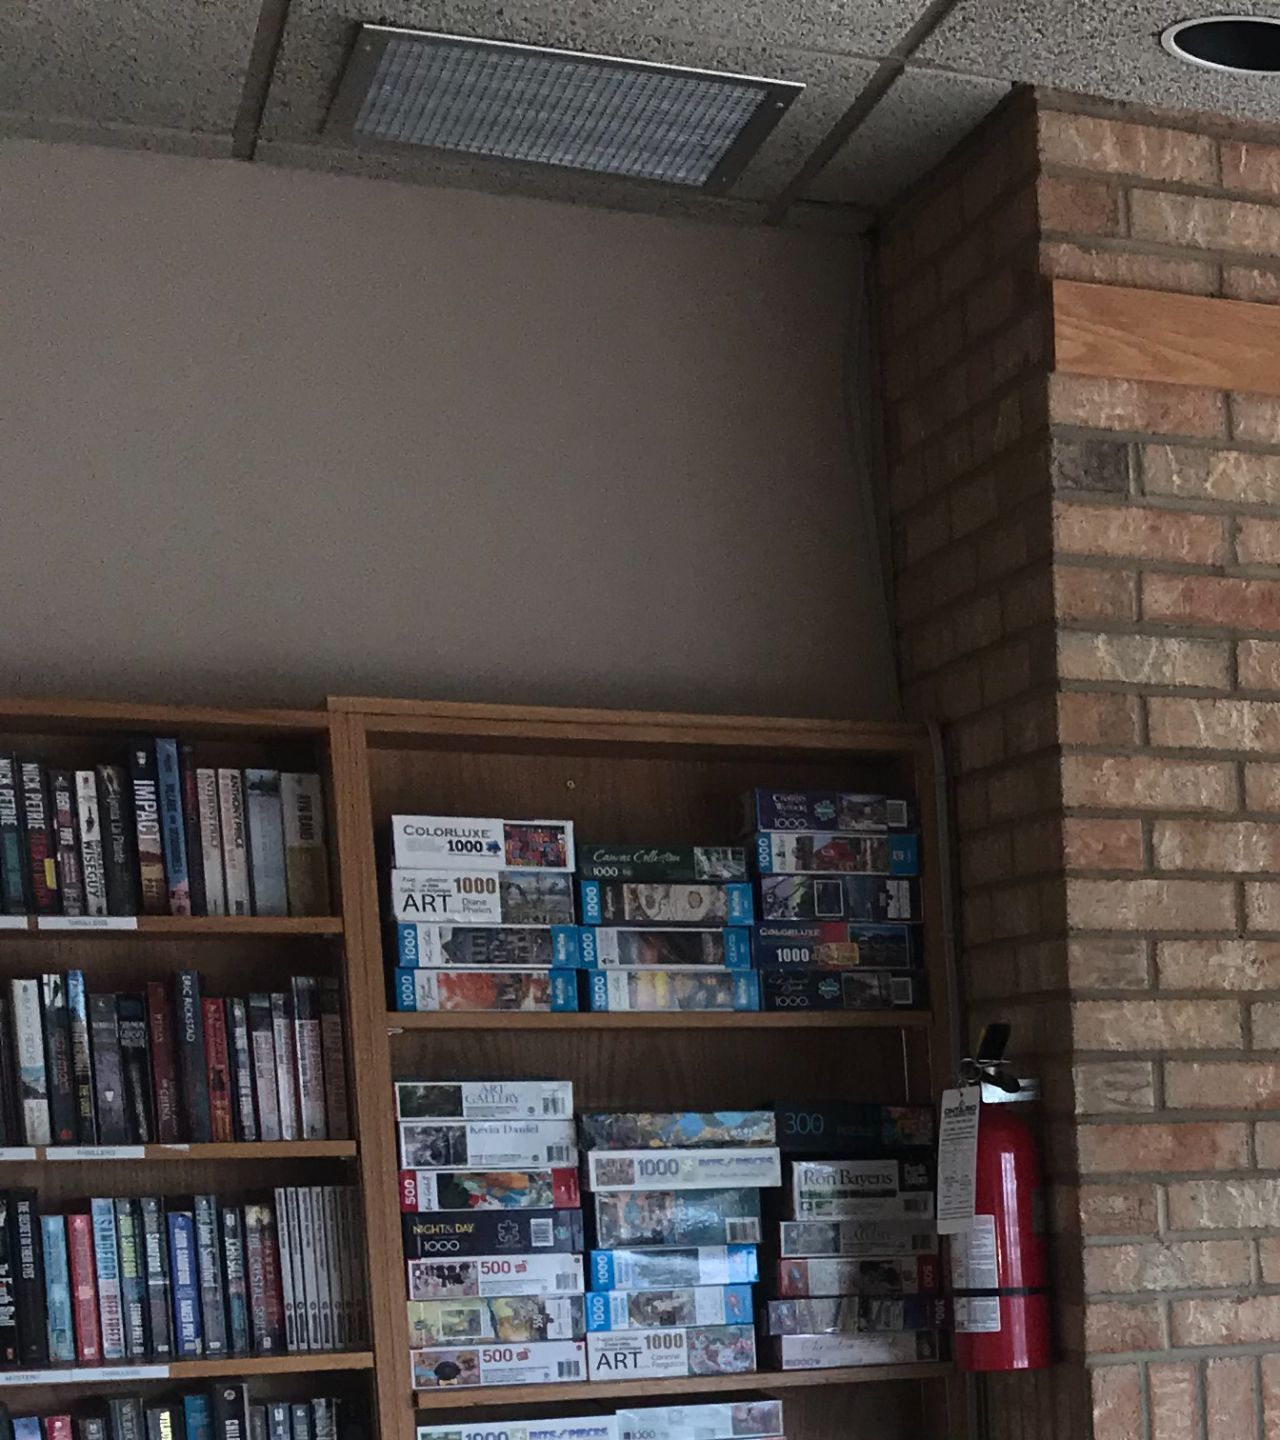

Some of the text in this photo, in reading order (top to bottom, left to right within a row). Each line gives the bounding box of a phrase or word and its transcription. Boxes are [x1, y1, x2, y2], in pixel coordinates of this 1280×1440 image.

[25, 792, 45, 830] PETRIE
[133, 780, 160, 840] IMPACT
[774, 817, 809, 830] 1000
[447, 840, 483, 853] 1000
[758, 838, 769, 868] 1000
[83, 841, 100, 898] WISEGUY
[592, 866, 619, 877] 1000
[454, 877, 497, 894] 1000
[402, 893, 453, 913] ART
[586, 886, 600, 917] 1000
[404, 929, 416, 961] 1000
[582, 932, 596, 963] 1000
[775, 948, 810, 963] 1000
[401, 975, 414, 1006] 1000
[594, 975, 607, 1007] 1000
[775, 995, 809, 1007] 1000
[465, 1093, 520, 1104] GALLERY
[481, 1085, 503, 1095] ART
[783, 1112, 825, 1135] 300
[638, 1159, 680, 1176] 1000
[803, 1168, 837, 1185] Ron
[403, 1179, 417, 1206] 500
[424, 1240, 461, 1252] 1000
[480, 1260, 512, 1275] 500
[598, 1256, 608, 1284] 1000
[594, 1296, 605, 1329] 1000
[643, 1334, 684, 1350] 1000
[482, 1348, 514, 1363] 500
[597, 1351, 644, 1370] ART
